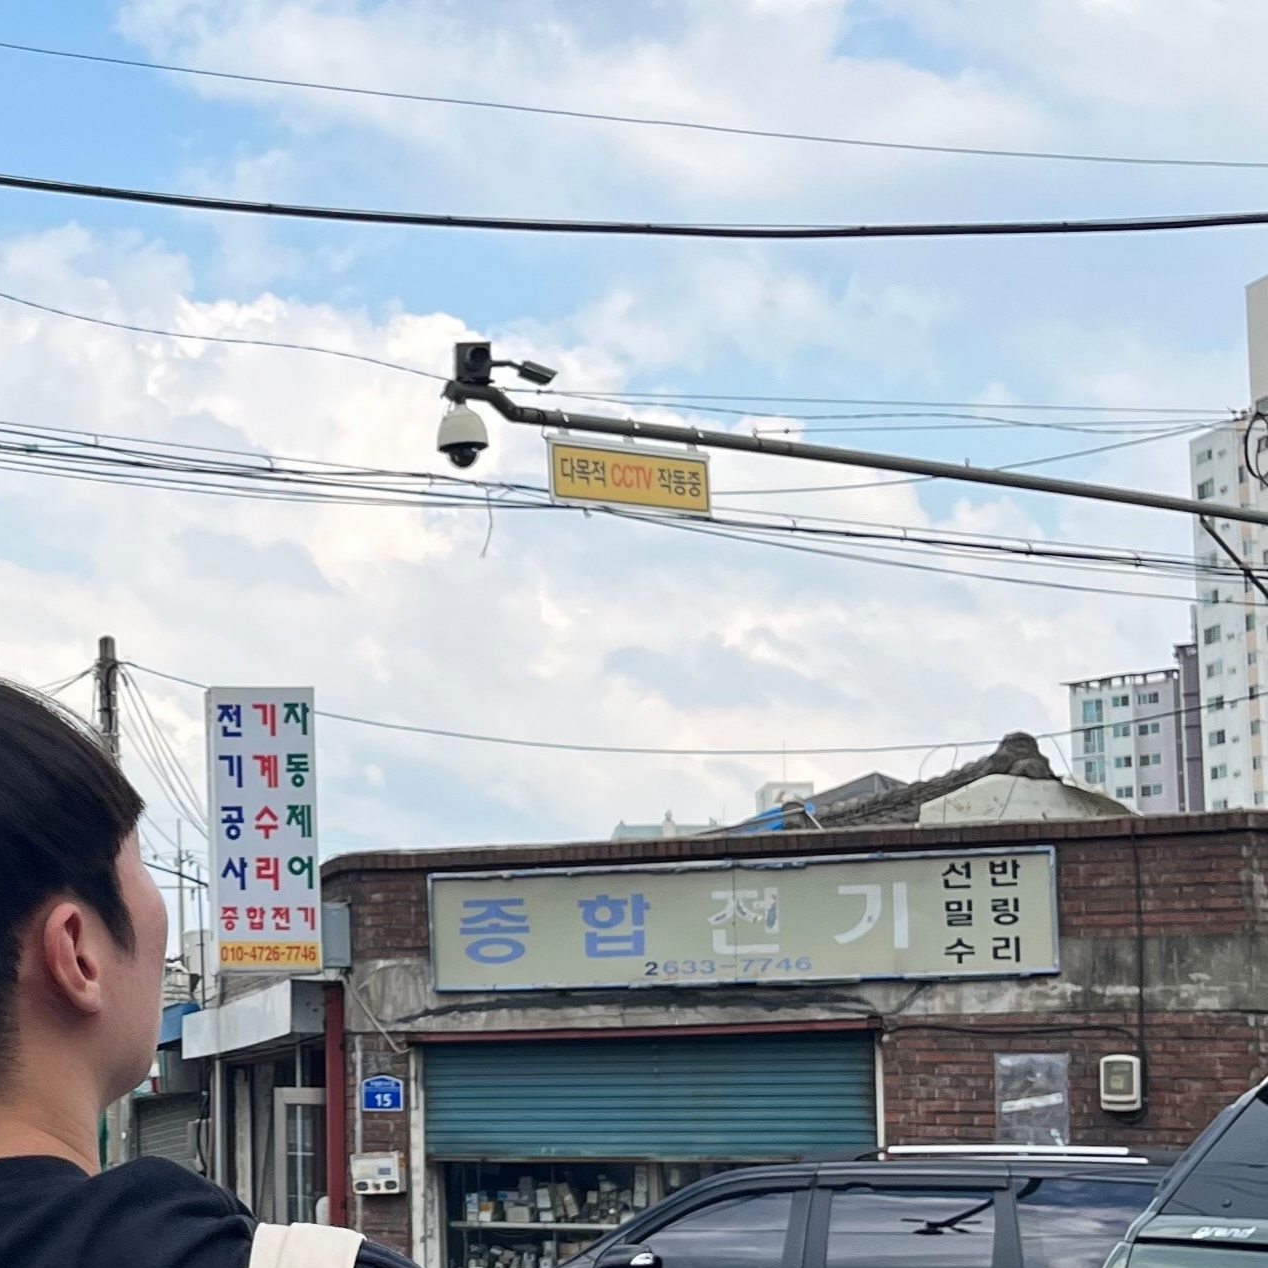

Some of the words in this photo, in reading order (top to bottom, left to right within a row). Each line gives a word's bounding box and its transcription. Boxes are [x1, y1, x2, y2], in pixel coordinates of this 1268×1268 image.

[560, 457, 605, 488] 다목적
[611, 463, 653, 491] CCTV
[657, 467, 701, 498] 작동중
[941, 859, 1021, 890] 선반
[220, 906, 316, 932] 종합전기
[944, 896, 1020, 927] 밀링
[220, 945, 317, 963] 010-4726-7746
[943, 936, 1021, 964] 수리
[644, 956, 813, 977] 2633-7746
[374, 1093, 392, 1108] 15
